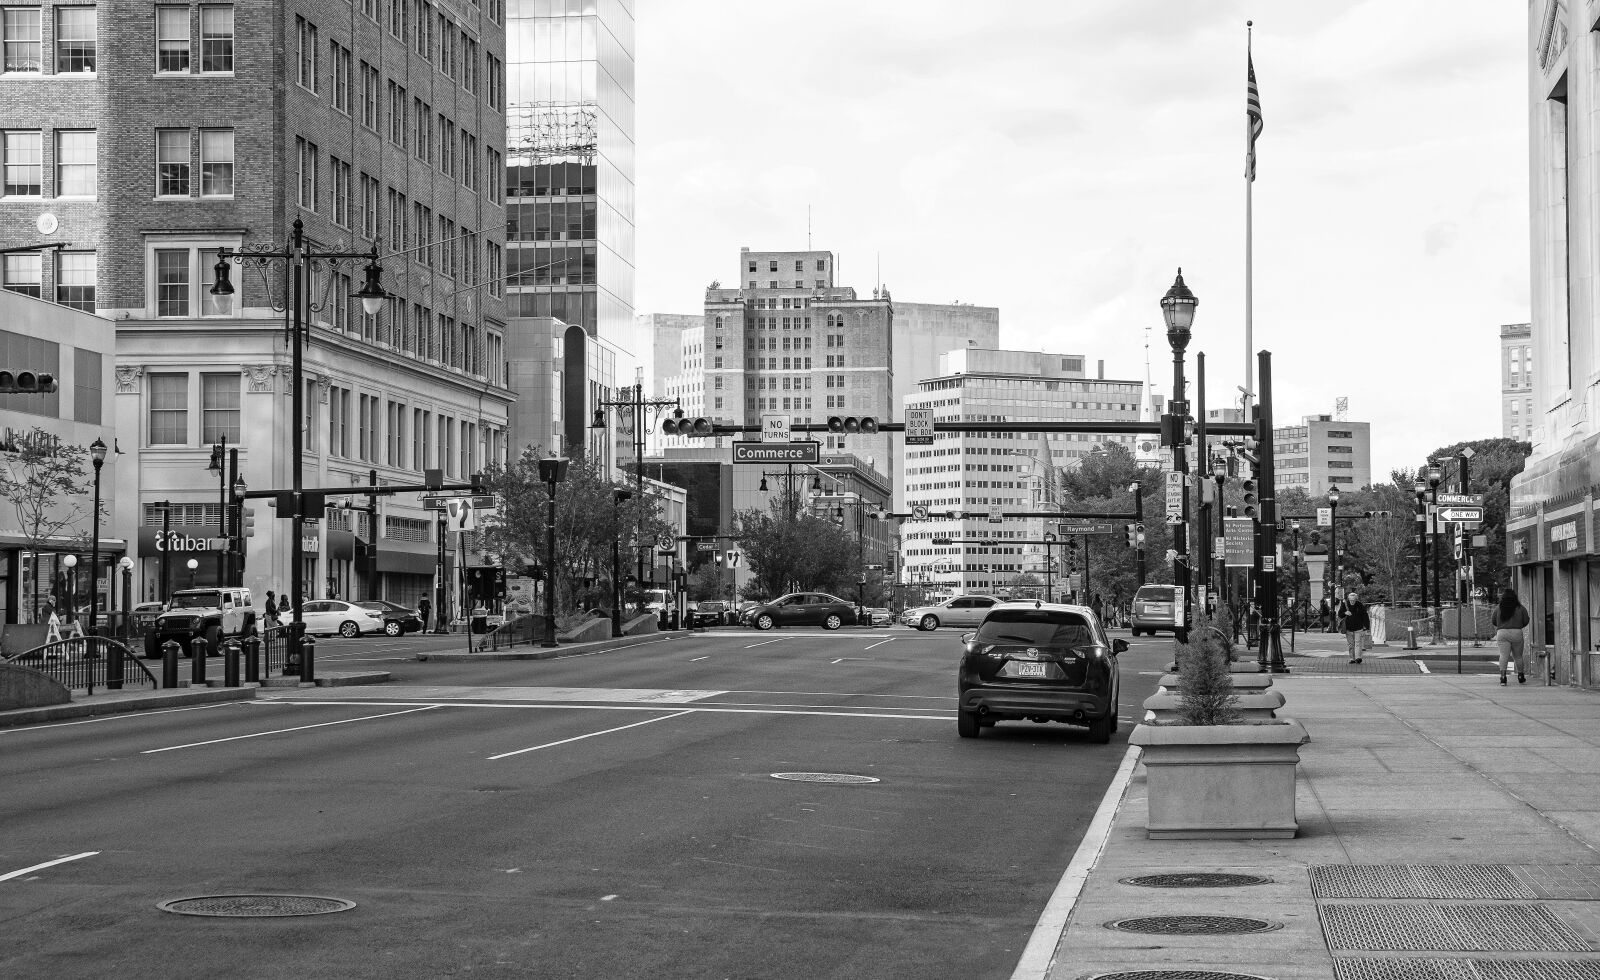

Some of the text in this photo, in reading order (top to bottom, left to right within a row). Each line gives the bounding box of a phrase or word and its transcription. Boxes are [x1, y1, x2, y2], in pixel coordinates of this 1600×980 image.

[770, 420, 782, 428] NO
[737, 447, 804, 458] Commerce
[1170, 474, 1178, 482] NO
[1438, 494, 1474, 504] COMMERCE
